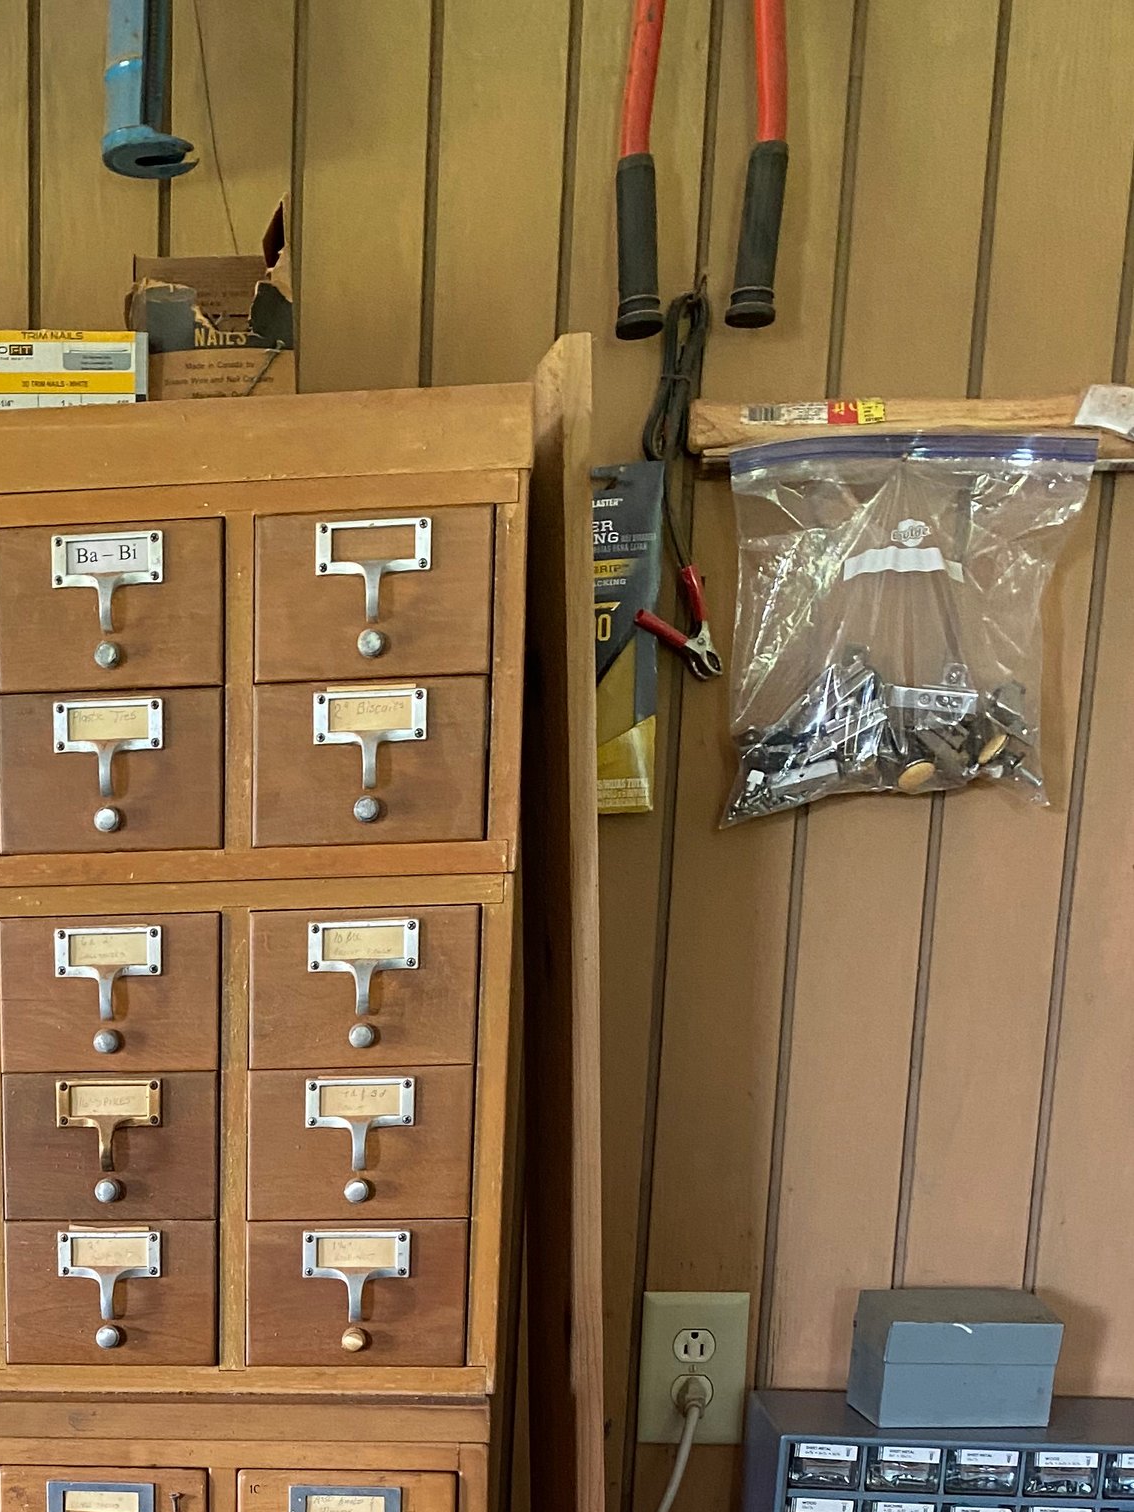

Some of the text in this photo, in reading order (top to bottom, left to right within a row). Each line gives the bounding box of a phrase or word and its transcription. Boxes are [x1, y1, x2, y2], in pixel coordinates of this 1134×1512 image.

[21, 331, 84, 340] TRIM NAILS
[194, 327, 248, 347] NAILS
[77, 547, 98, 564] Ba
[118, 542, 137, 560] Bi
